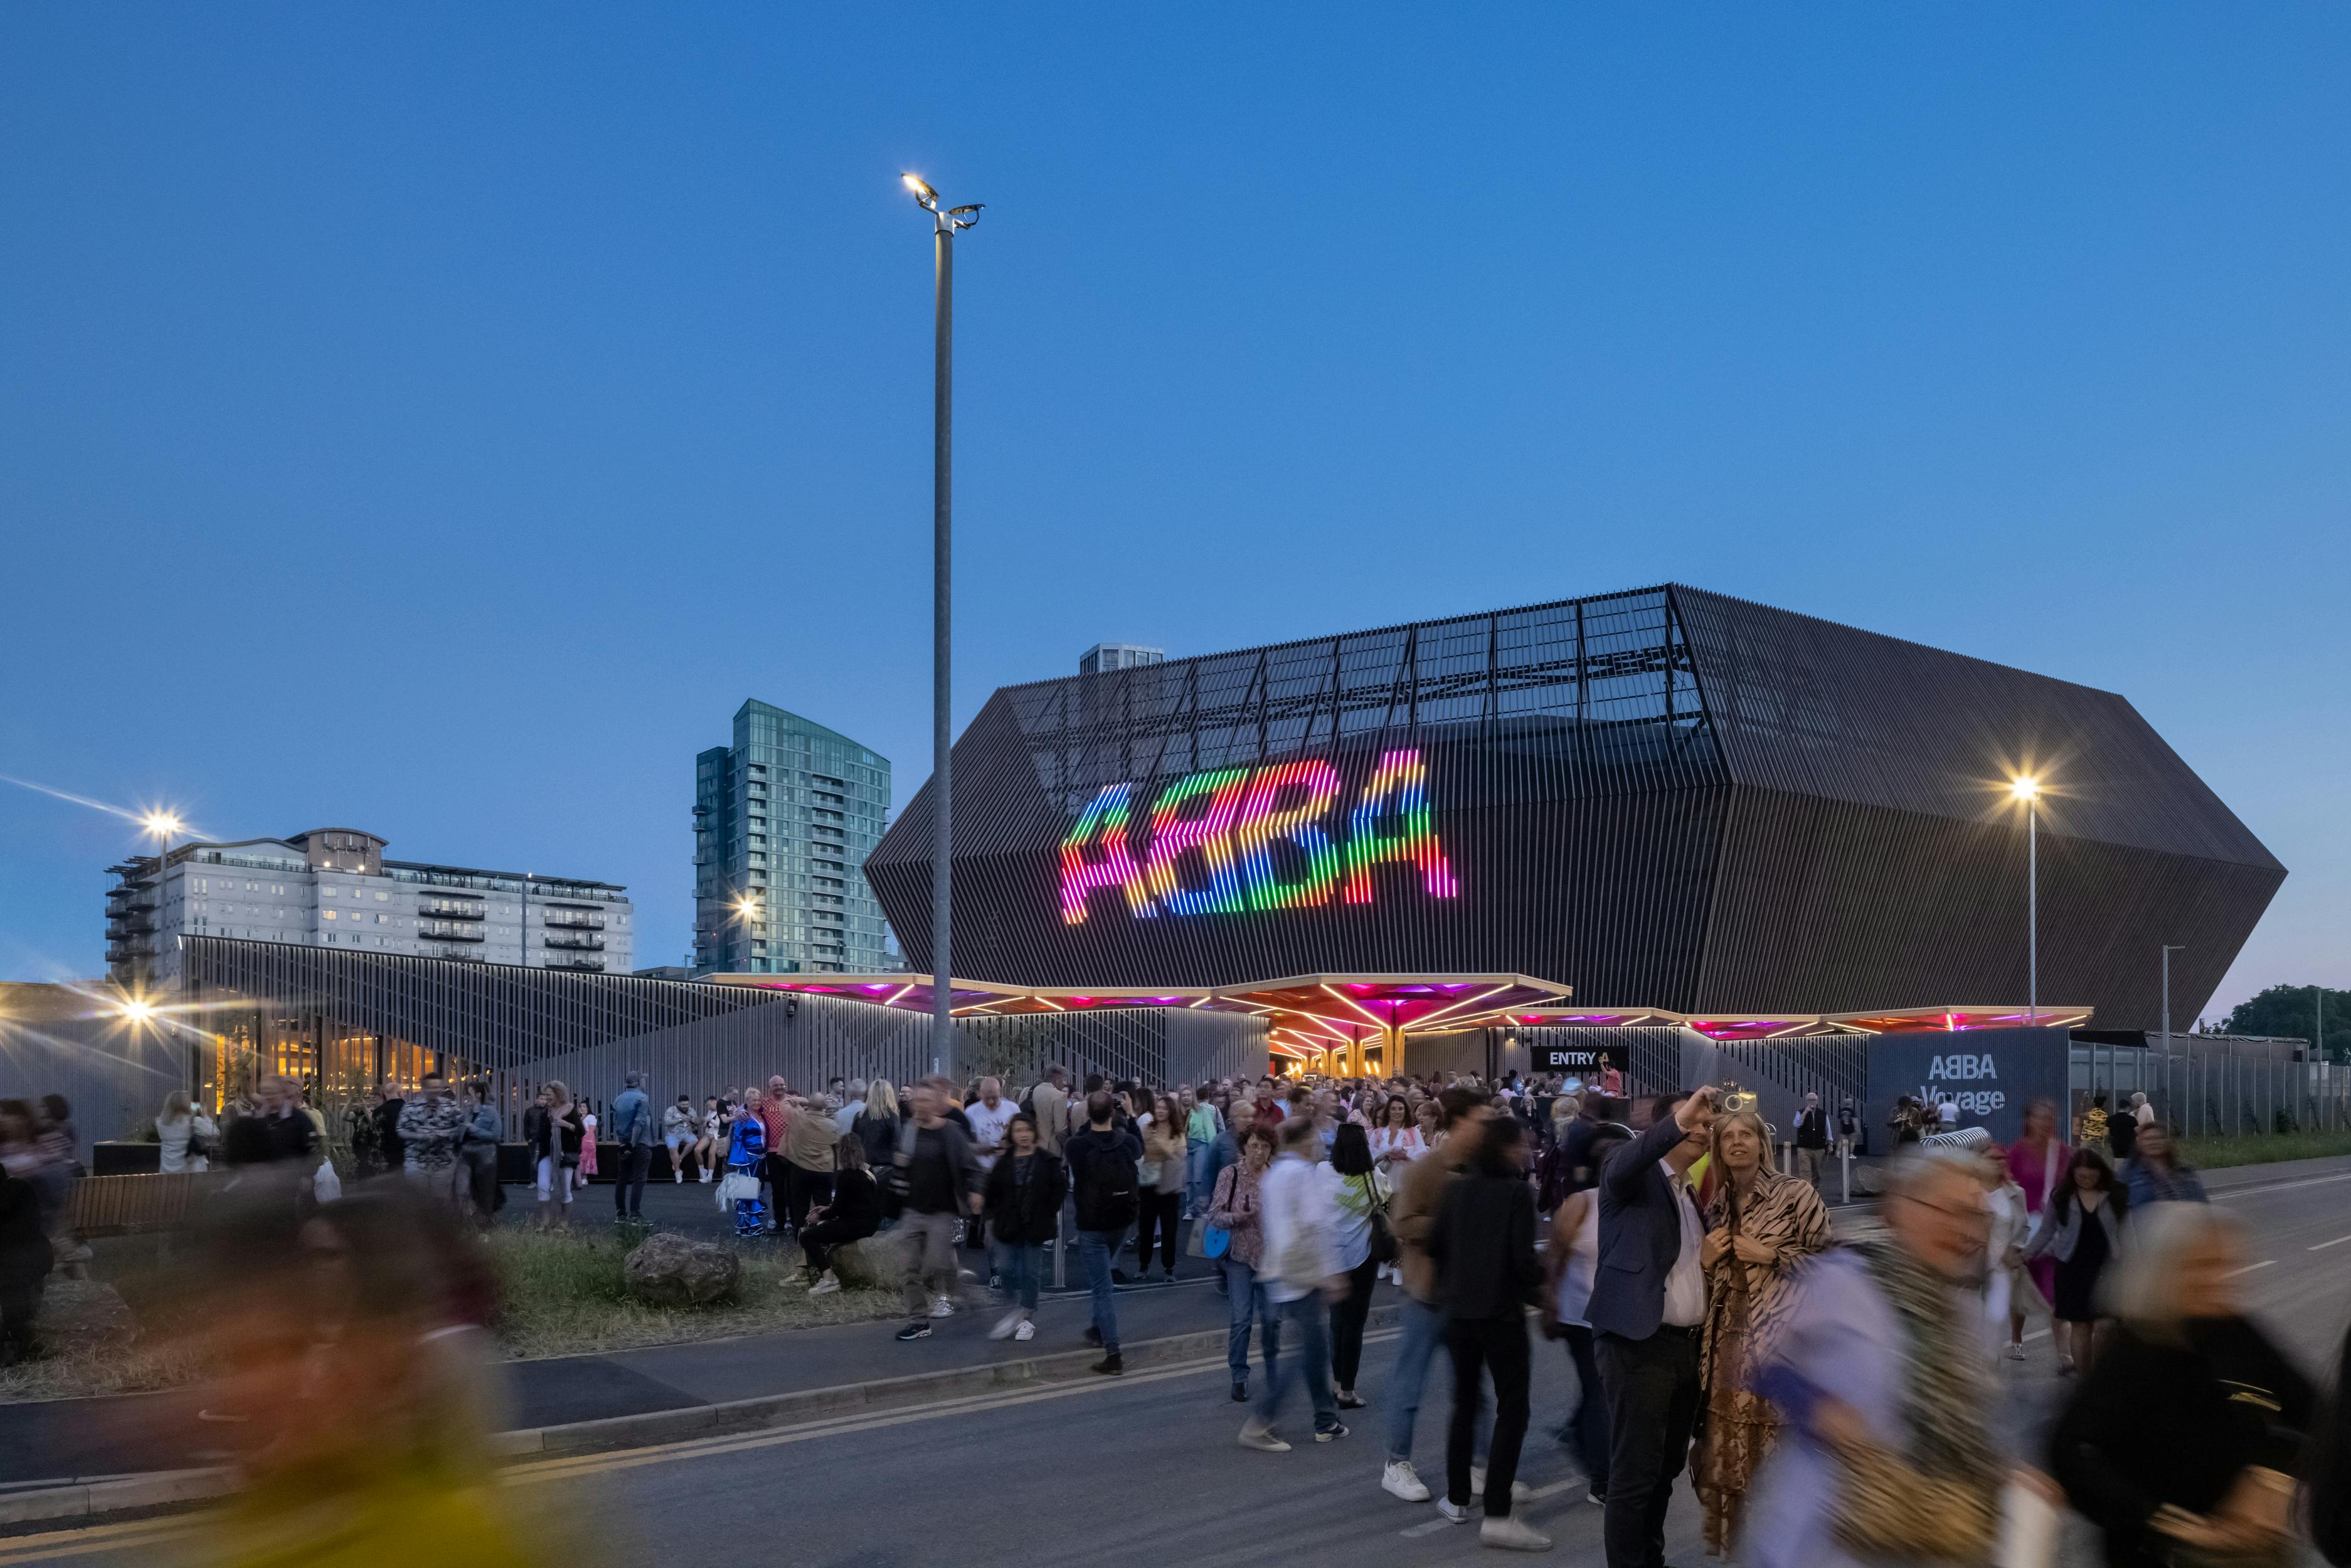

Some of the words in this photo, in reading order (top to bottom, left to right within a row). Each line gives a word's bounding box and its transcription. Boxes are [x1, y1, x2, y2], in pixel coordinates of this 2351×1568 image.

[1061, 749, 1457, 924] ABBA
[1550, 1052, 1596, 1065] ENTRY
[1928, 1054, 1997, 1080] ABBA
